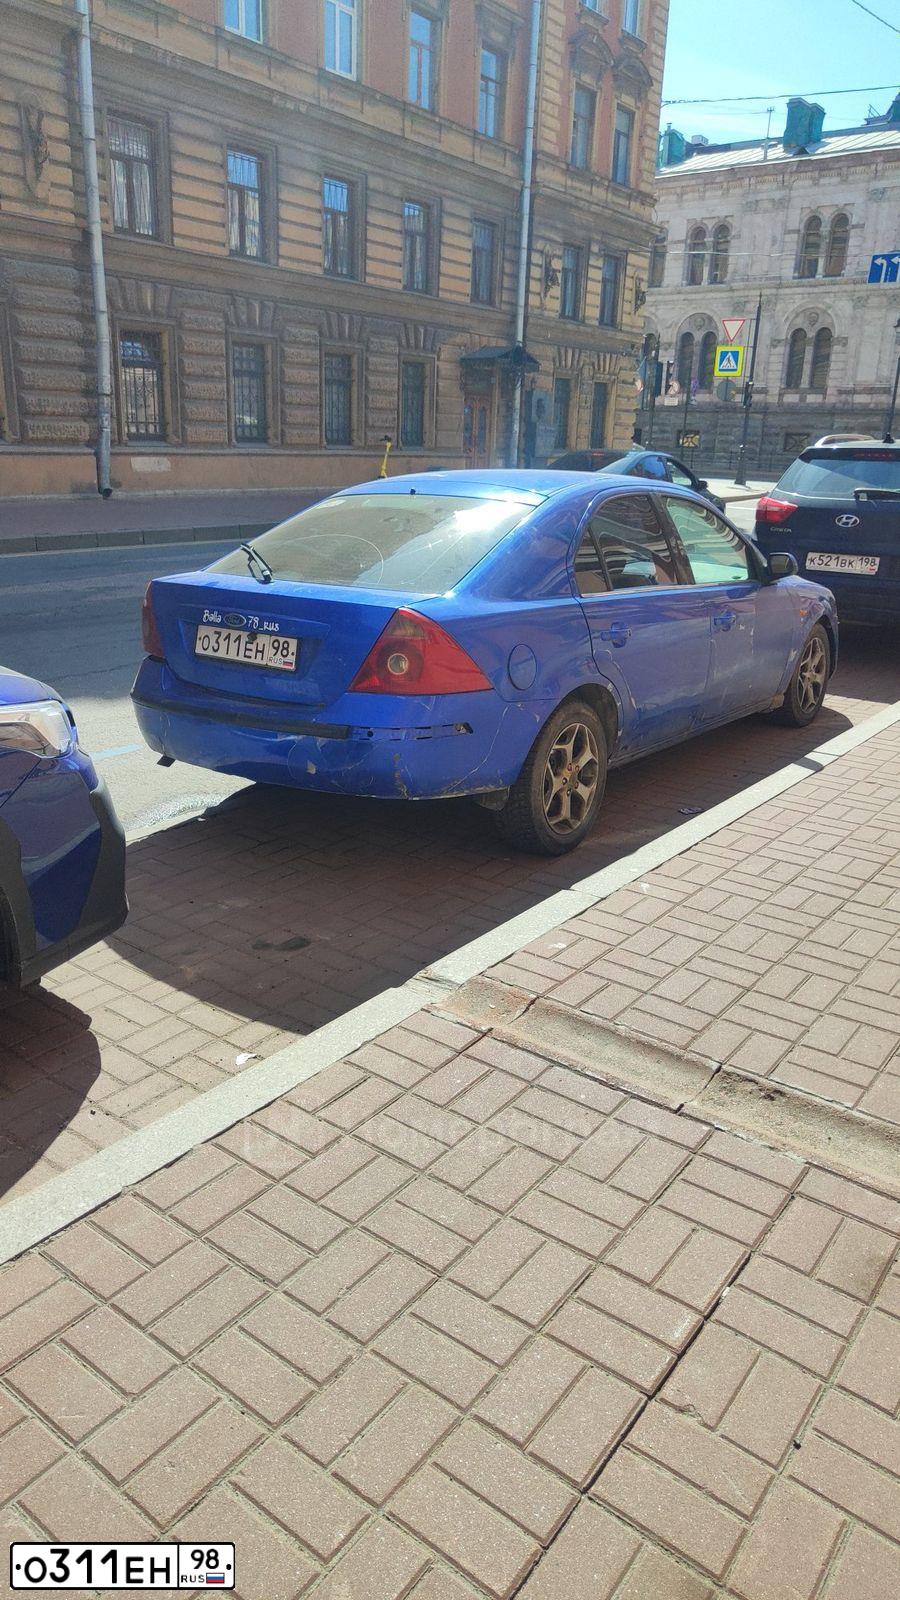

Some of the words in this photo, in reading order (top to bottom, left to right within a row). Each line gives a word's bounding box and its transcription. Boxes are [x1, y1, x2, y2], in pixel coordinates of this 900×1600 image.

[809, 554, 856, 568] К521ВК
[859, 556, 876, 567] 198
[201, 630, 266, 660] О311ЕН
[271, 639, 290, 658] 98
[268, 656, 283, 665] RUS
